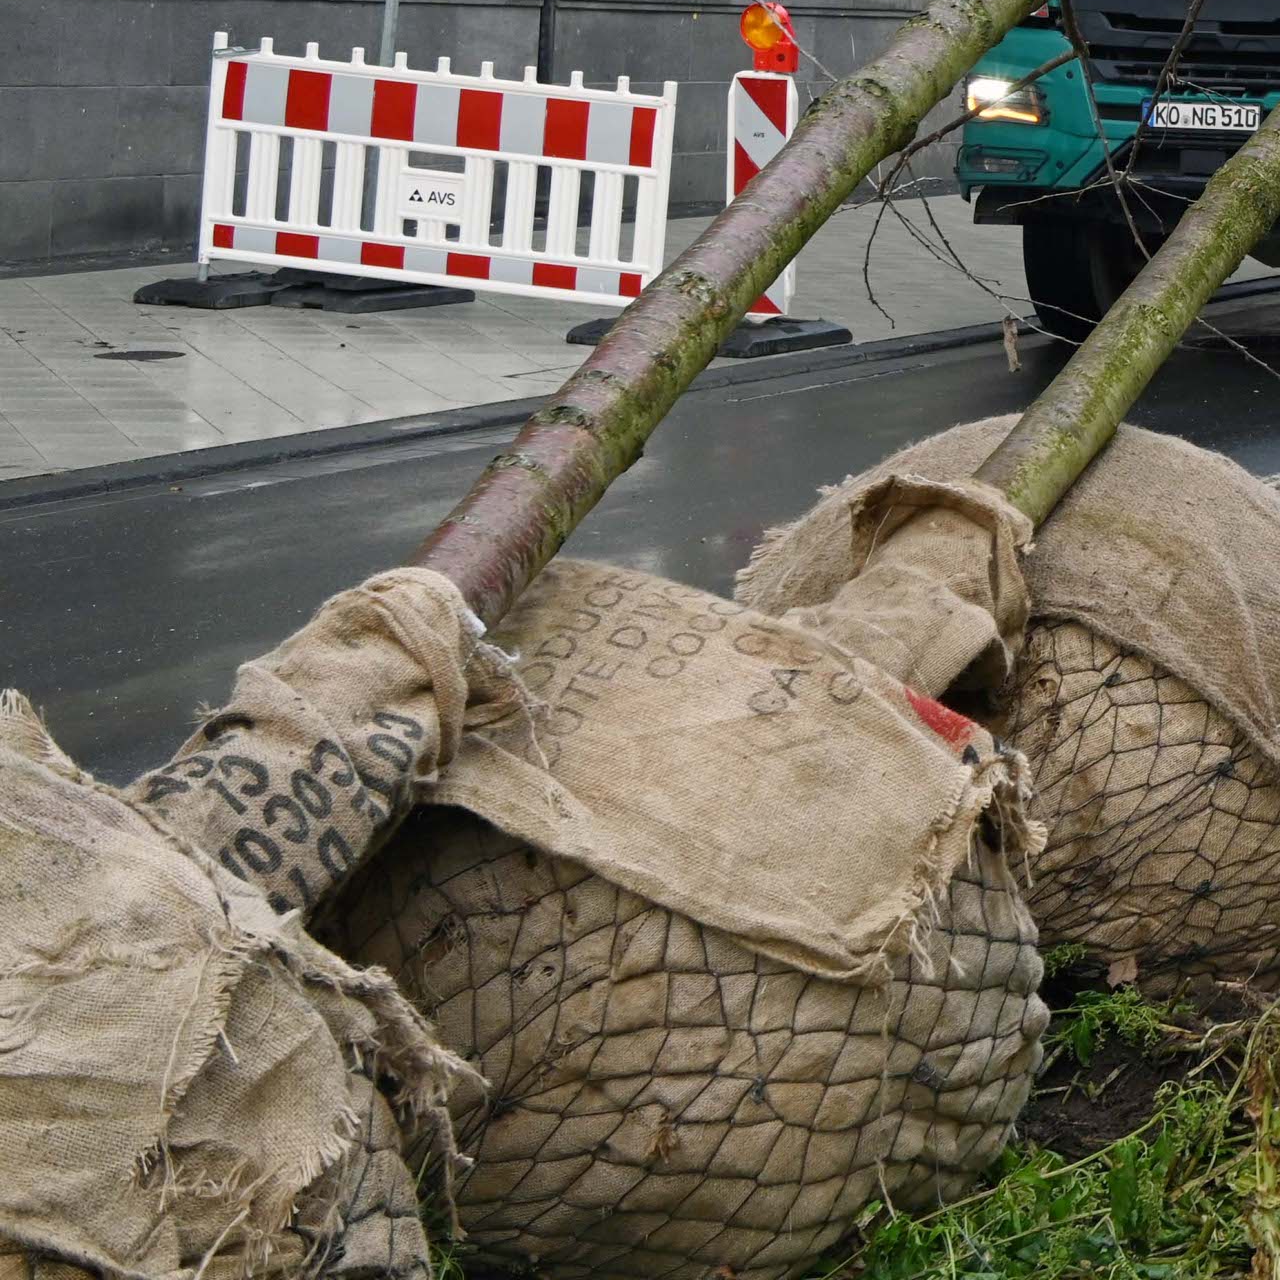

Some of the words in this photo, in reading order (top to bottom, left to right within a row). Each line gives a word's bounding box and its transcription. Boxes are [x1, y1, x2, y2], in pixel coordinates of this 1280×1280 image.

[1155, 105, 1180, 126] KO
[1191, 108, 1217, 127] NG
[1221, 108, 1258, 128] 510
[427, 190, 456, 206] AVS
